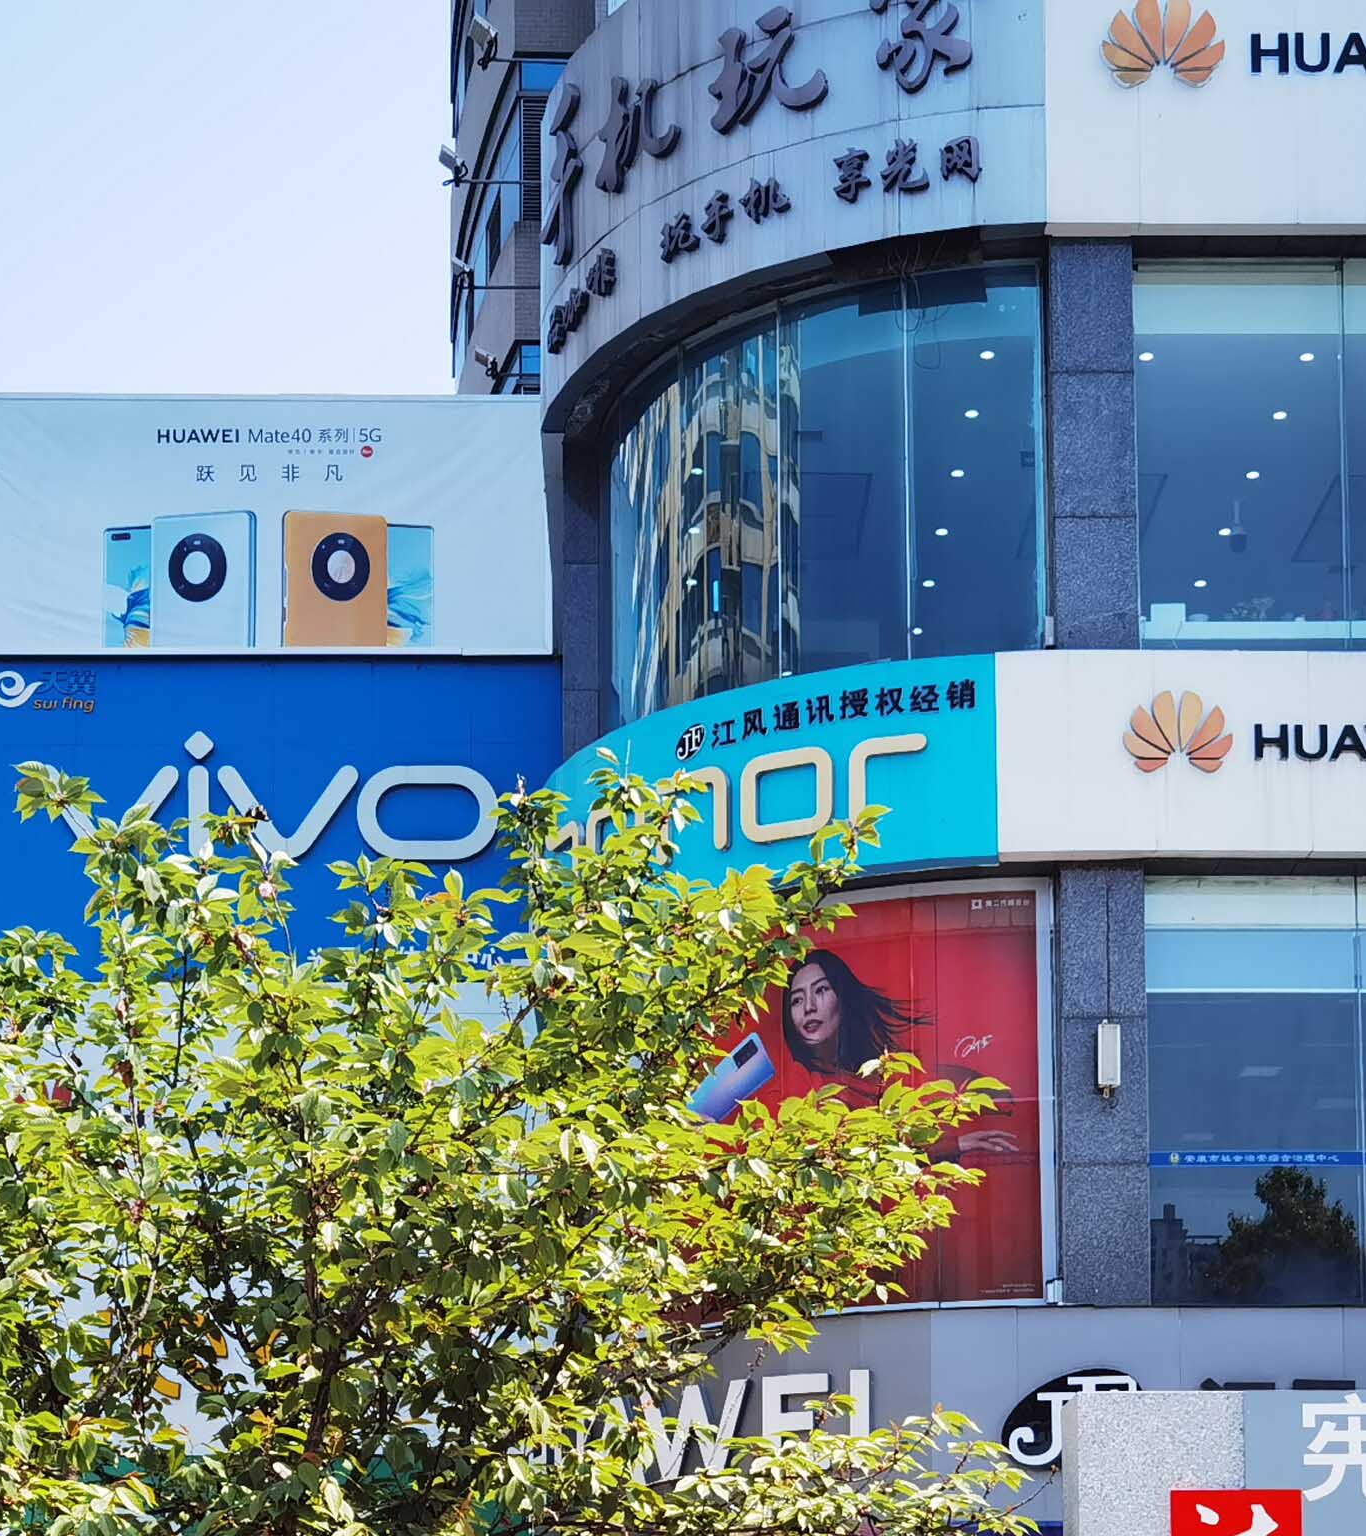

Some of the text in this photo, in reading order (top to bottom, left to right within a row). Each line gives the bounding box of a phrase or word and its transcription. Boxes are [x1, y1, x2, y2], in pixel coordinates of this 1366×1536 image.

[157, 427, 382, 444] HUAWEI Mate40 系列 5G
[196, 464, 343, 482] 跃见非凡
[711, 679, 976, 749] 江风通讯授权经销
[34, 730, 499, 860] vivo
[543, 733, 927, 870] nor
